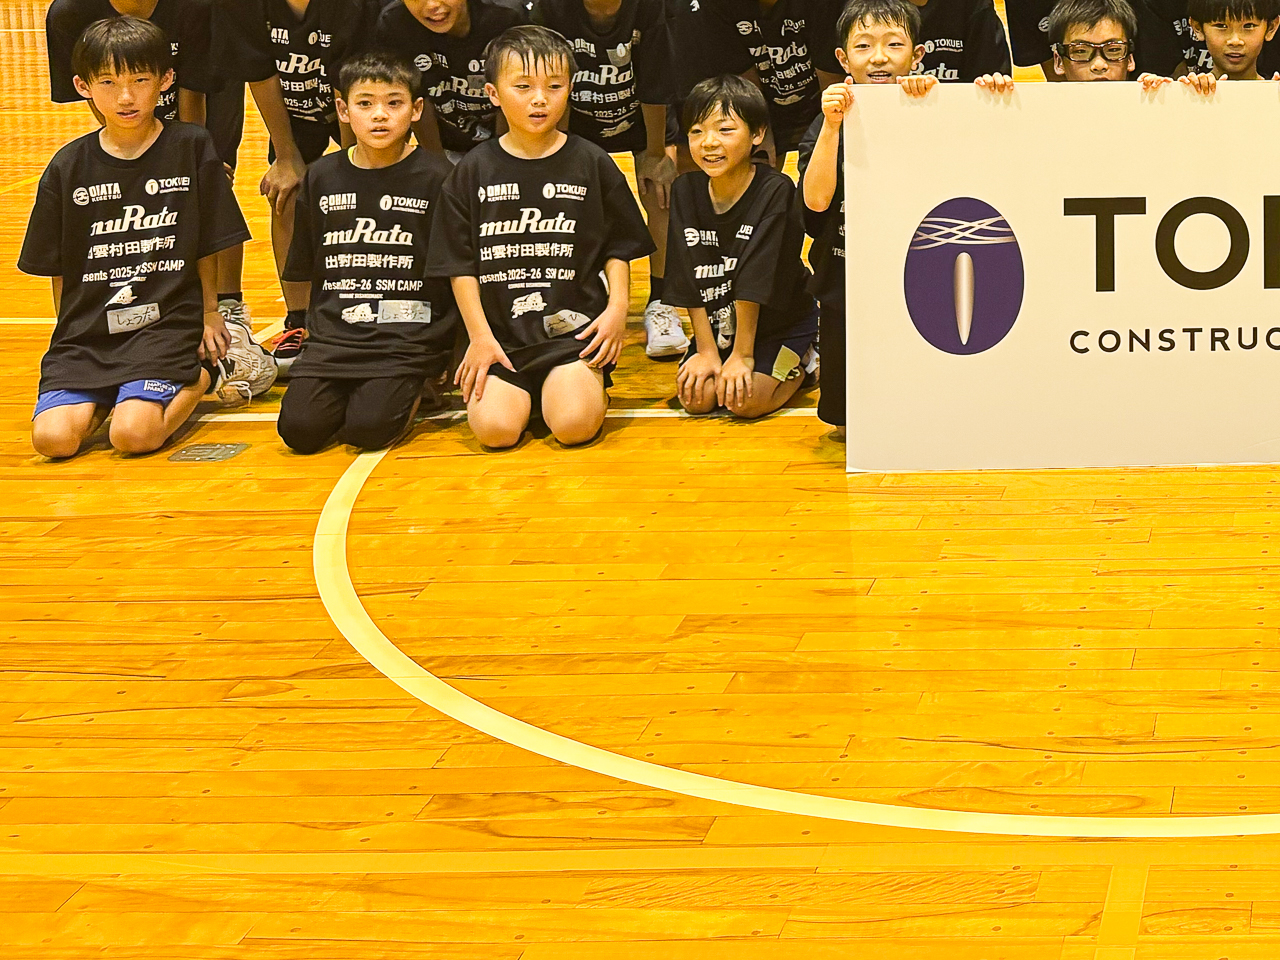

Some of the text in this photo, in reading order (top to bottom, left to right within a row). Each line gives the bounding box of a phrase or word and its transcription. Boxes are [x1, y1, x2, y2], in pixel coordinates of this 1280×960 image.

[486, 182, 520, 198] OHATA
[555, 183, 588, 196] TOKUEI
[392, 196, 429, 210] TOKUEI
[479, 207, 577, 237] muRata
[479, 242, 574, 262] 出雲村田製作所
[158, 260, 186, 276] CAMP
[479, 270, 508, 284] resents
[508, 267, 542, 281] 2025-26
[375, 279, 396, 292] SSM
[397, 279, 424, 292] CAMP
